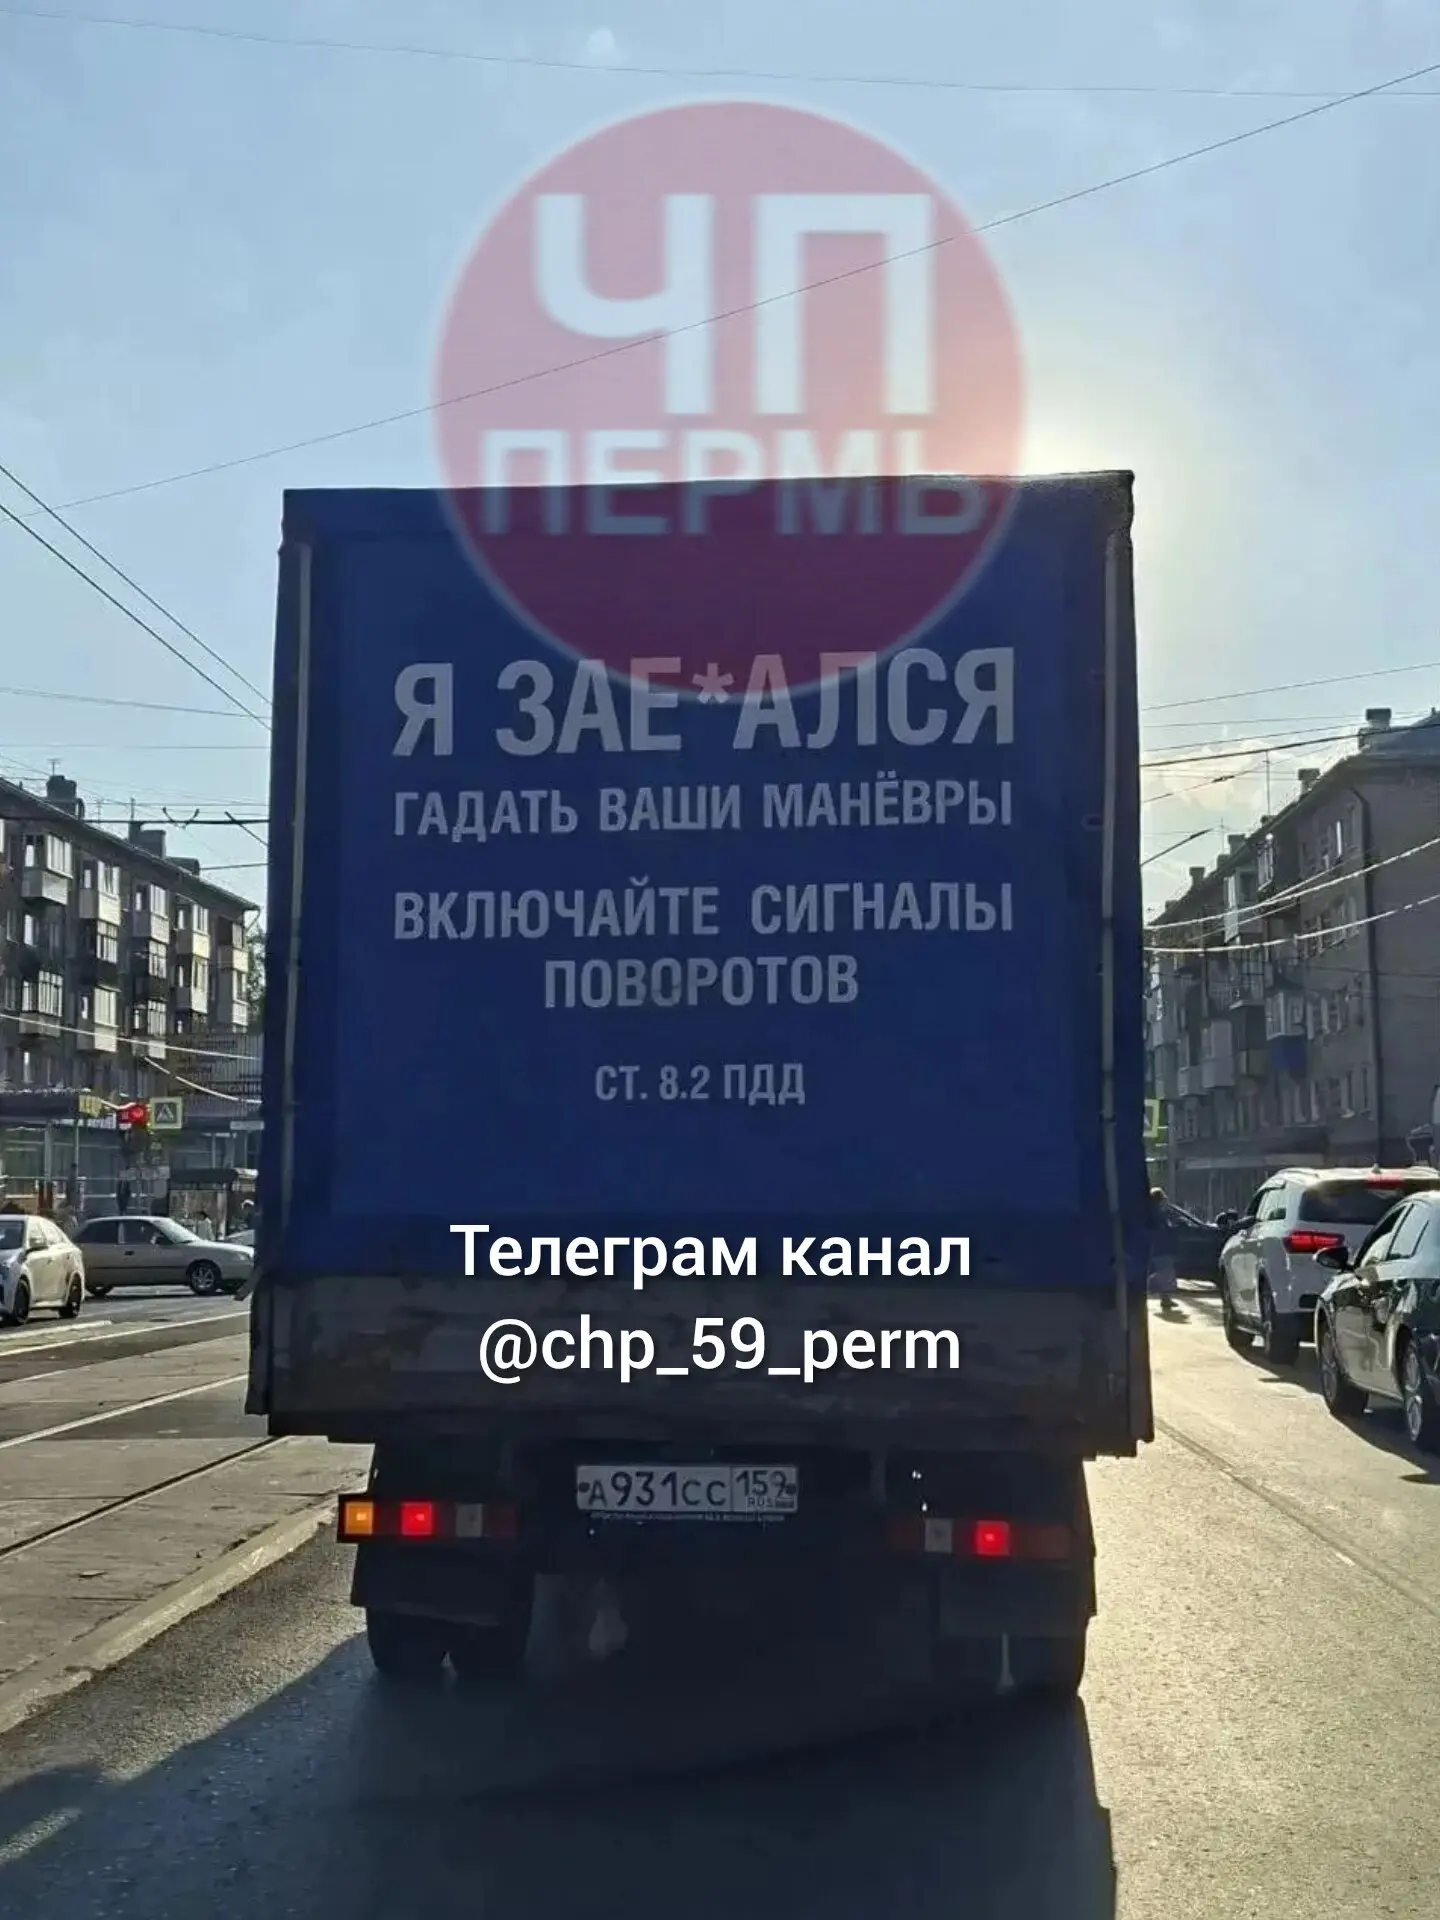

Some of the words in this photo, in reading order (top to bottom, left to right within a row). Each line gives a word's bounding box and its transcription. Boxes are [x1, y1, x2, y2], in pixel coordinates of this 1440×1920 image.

[393, 662, 454, 757] Я
[393, 789, 579, 843] ГАДАТЬ
[599, 784, 741, 832] ВАШИ
[763, 769, 1013, 828] МАНЁВРЫ
[393, 875, 720, 941] ВКЛЮЧАЙТЕ
[750, 882, 1013, 933] СИГНАЛЫ
[543, 954, 859, 1008] ПОВОРОТОВ
[594, 1065, 648, 1102] СТ.
[659, 1063, 711, 1101] 8.2
[723, 1062, 806, 1107] ПДД
